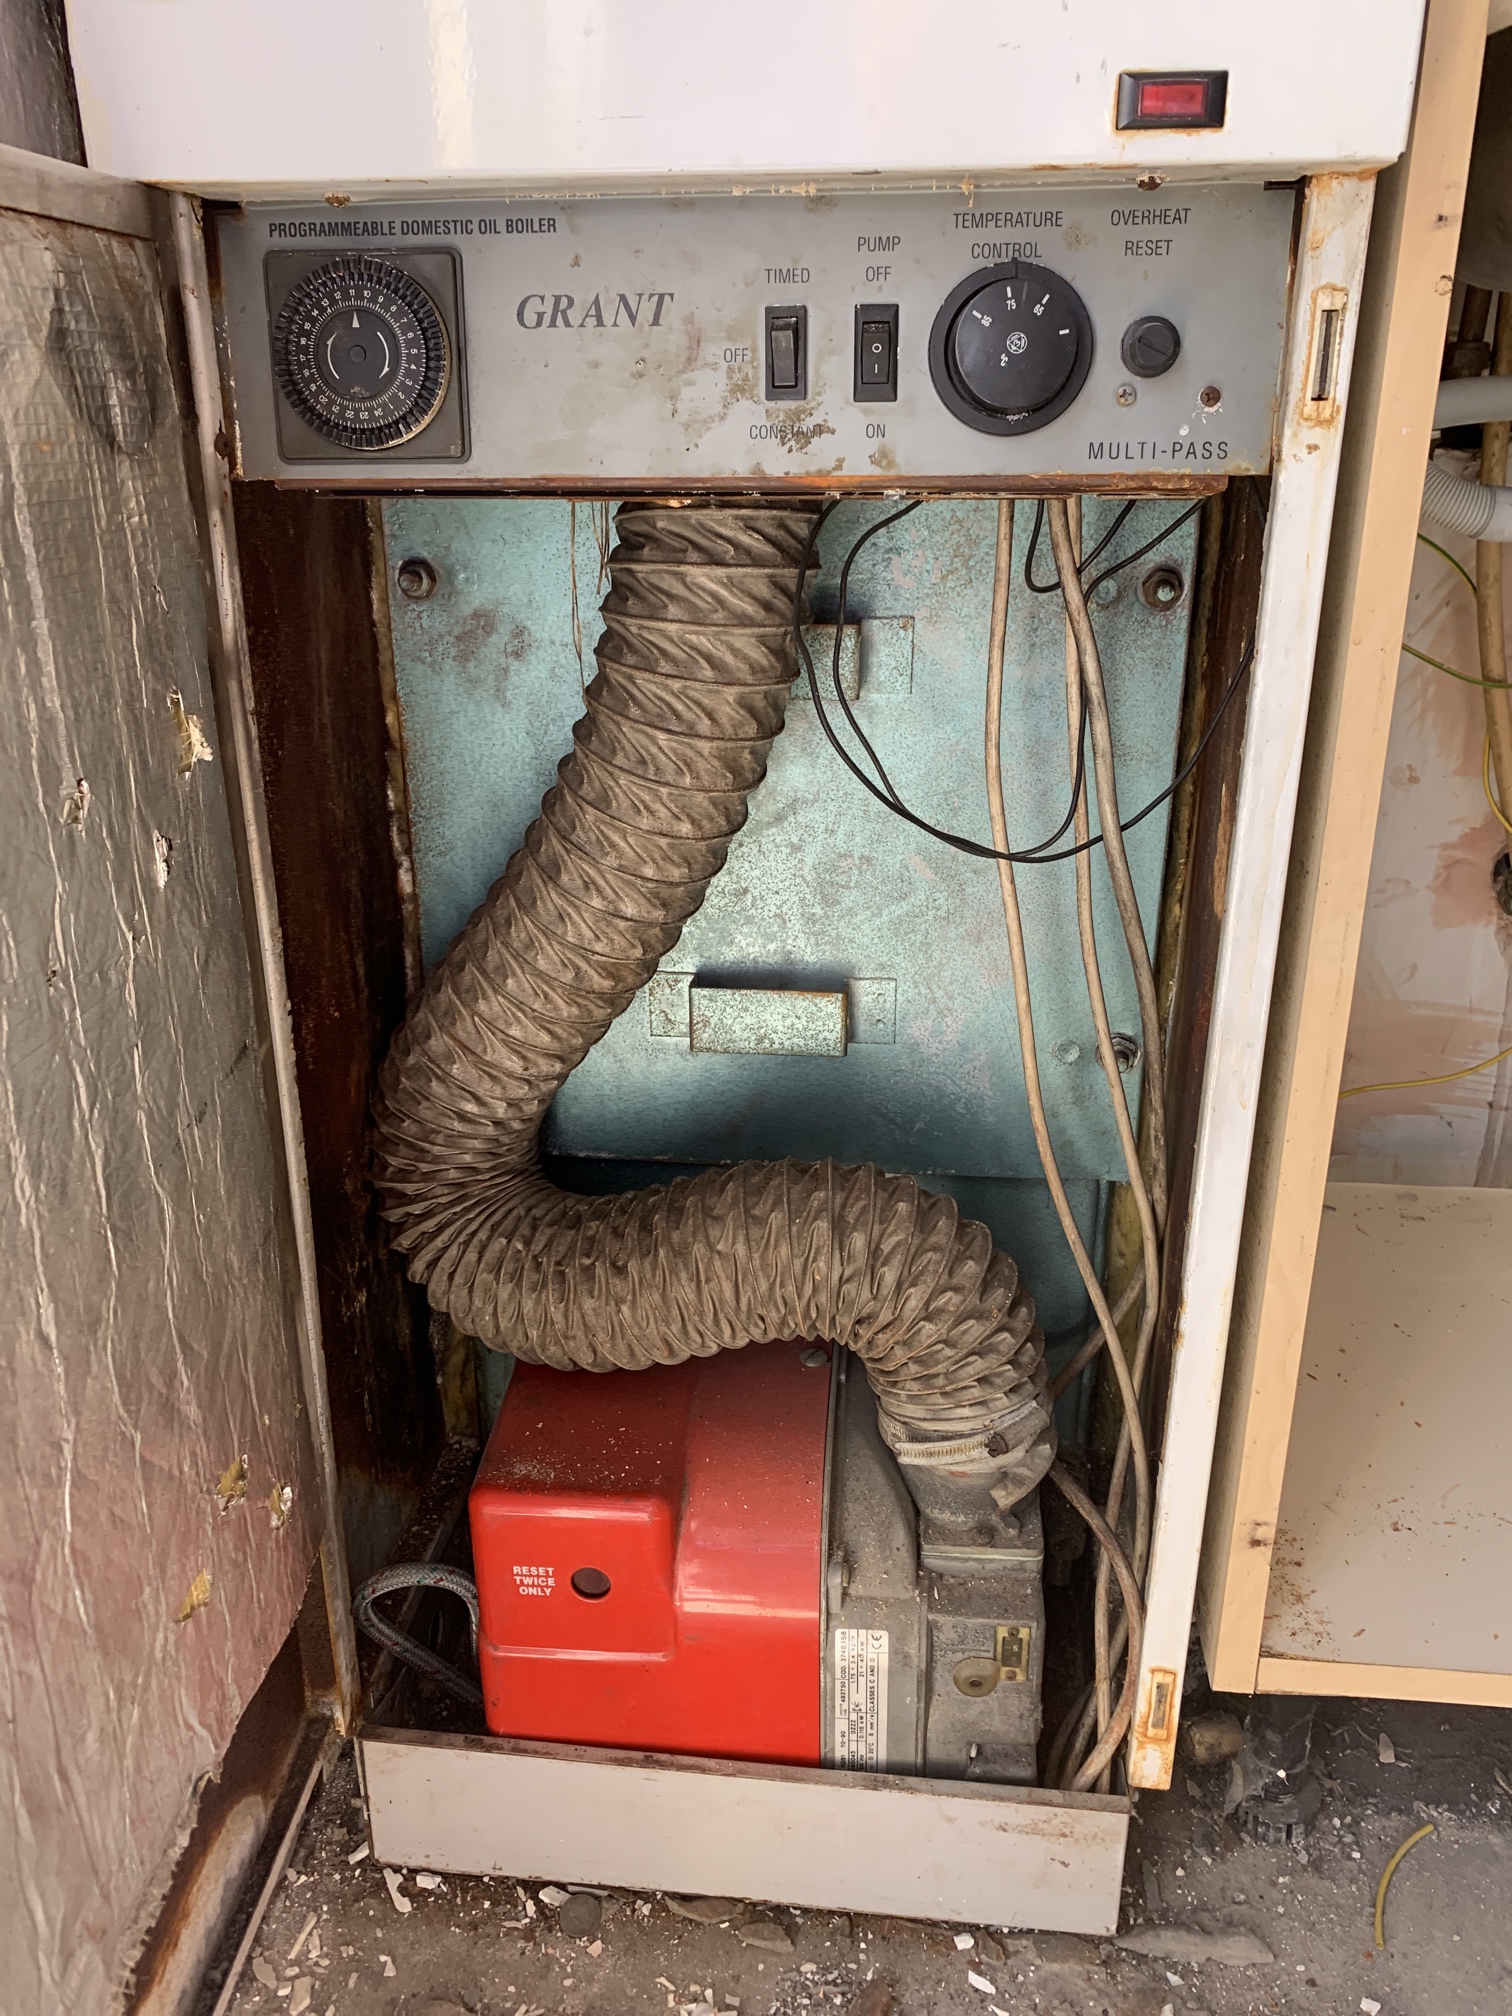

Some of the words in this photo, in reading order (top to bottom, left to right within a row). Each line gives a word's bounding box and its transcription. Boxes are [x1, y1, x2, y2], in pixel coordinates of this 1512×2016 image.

[954, 212, 1063, 229] TEMPERATURE
[1111, 209, 1190, 226] OVERHEAT
[269, 220, 396, 239] PROGRAMMEABLE
[401, 218, 474, 235] DOMESTIC
[478, 218, 502, 234] OIL
[506, 217, 557, 234] BOILER
[858, 236, 900, 252] PUMP
[972, 242, 1042, 259] CONTROL
[1125, 240, 1172, 256] RESET
[765, 268, 810, 283] TIMED
[866, 266, 891, 281] OFF
[516, 292, 674, 330] GRANT
[1006, 300, 1016, 310] 75
[1033, 304, 1045, 316] 65
[304, 322, 311, 330] 15
[981, 315, 993, 327] 85
[723, 347, 749, 364] OFF
[319, 394, 328, 403] 20
[331, 405, 340, 413] 21
[345, 410, 354, 418] 22
[375, 408, 383, 417] 24
[750, 424, 824, 439] CONSTANT
[866, 424, 886, 439] ON
[1089, 441, 1229, 460] MULTI-PASS
[513, 1566, 554, 1576] RESET
[514, 1576, 556, 1586] TWICE
[519, 1587, 552, 1596] ONLY
[872, 1635, 882, 1649] CE
